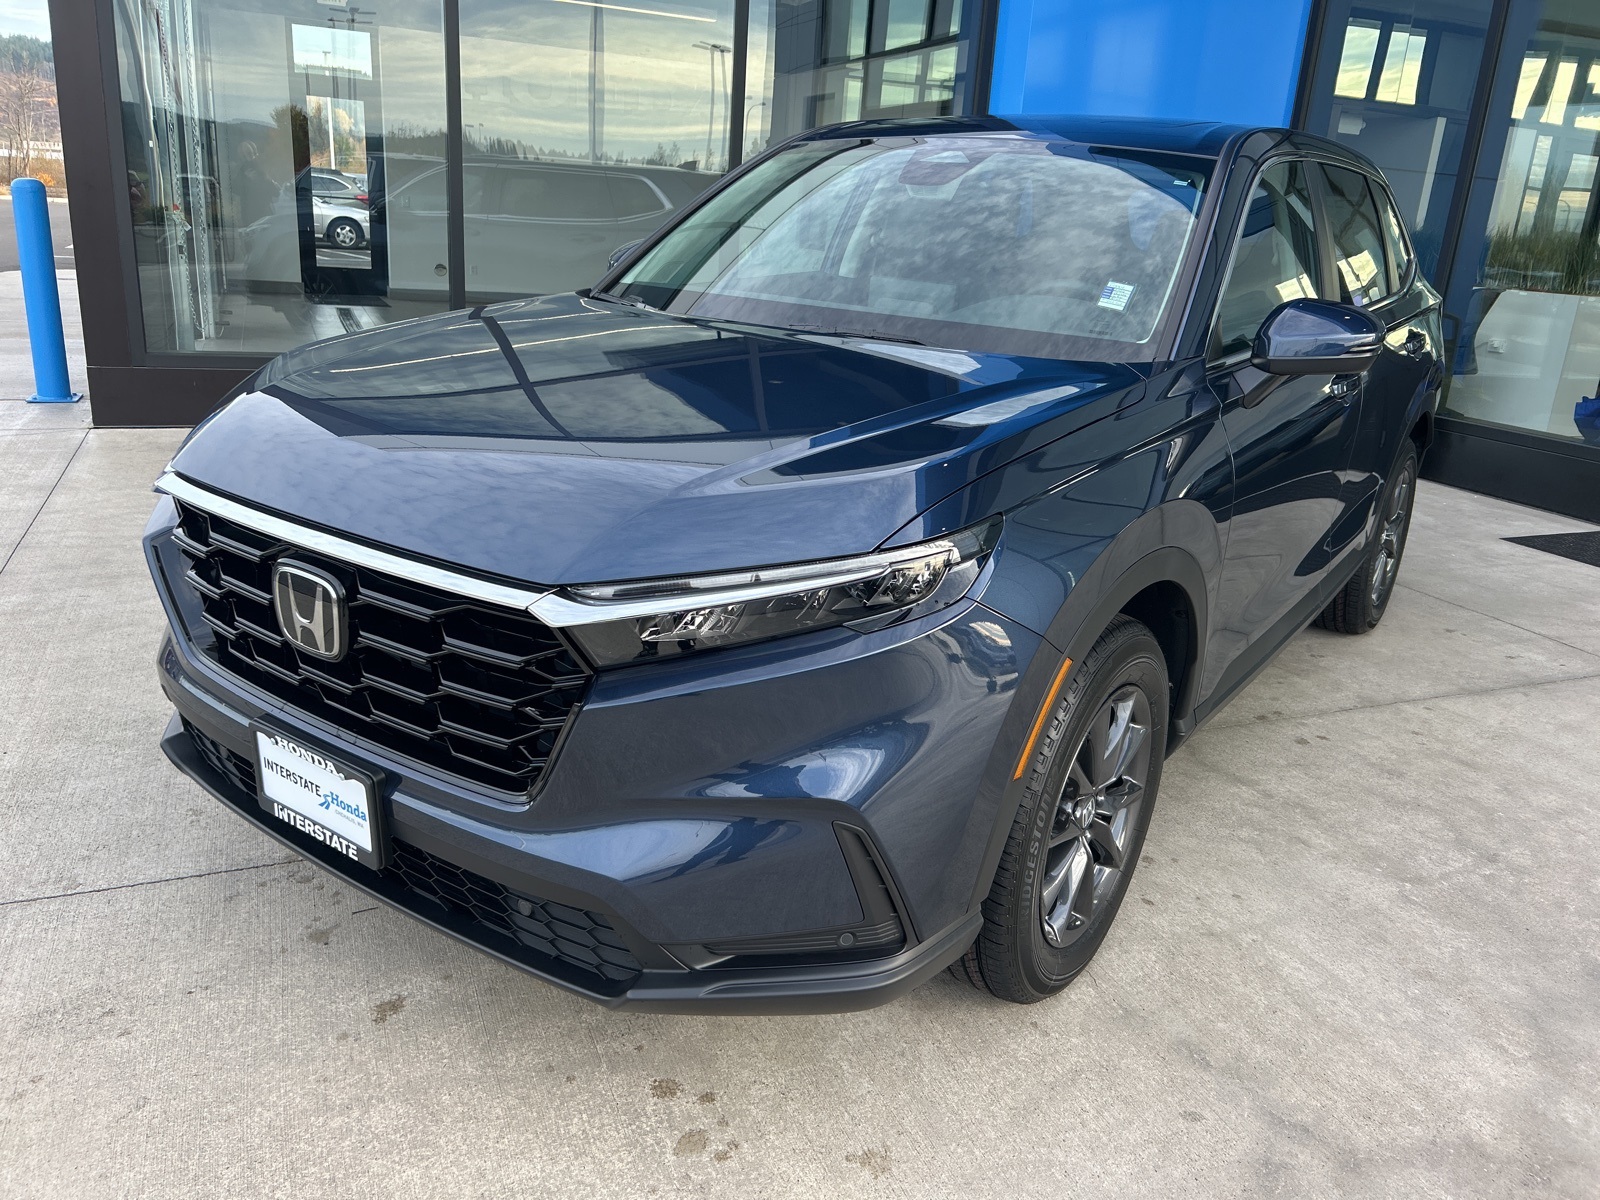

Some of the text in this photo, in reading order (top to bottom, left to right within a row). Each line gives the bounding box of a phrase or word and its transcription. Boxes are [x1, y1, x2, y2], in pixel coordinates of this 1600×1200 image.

[263, 756, 322, 797] INTERSTATE
[275, 735, 339, 777] HONDA
[329, 791, 367, 822] Honda
[274, 802, 358, 862] INTERSTATE
